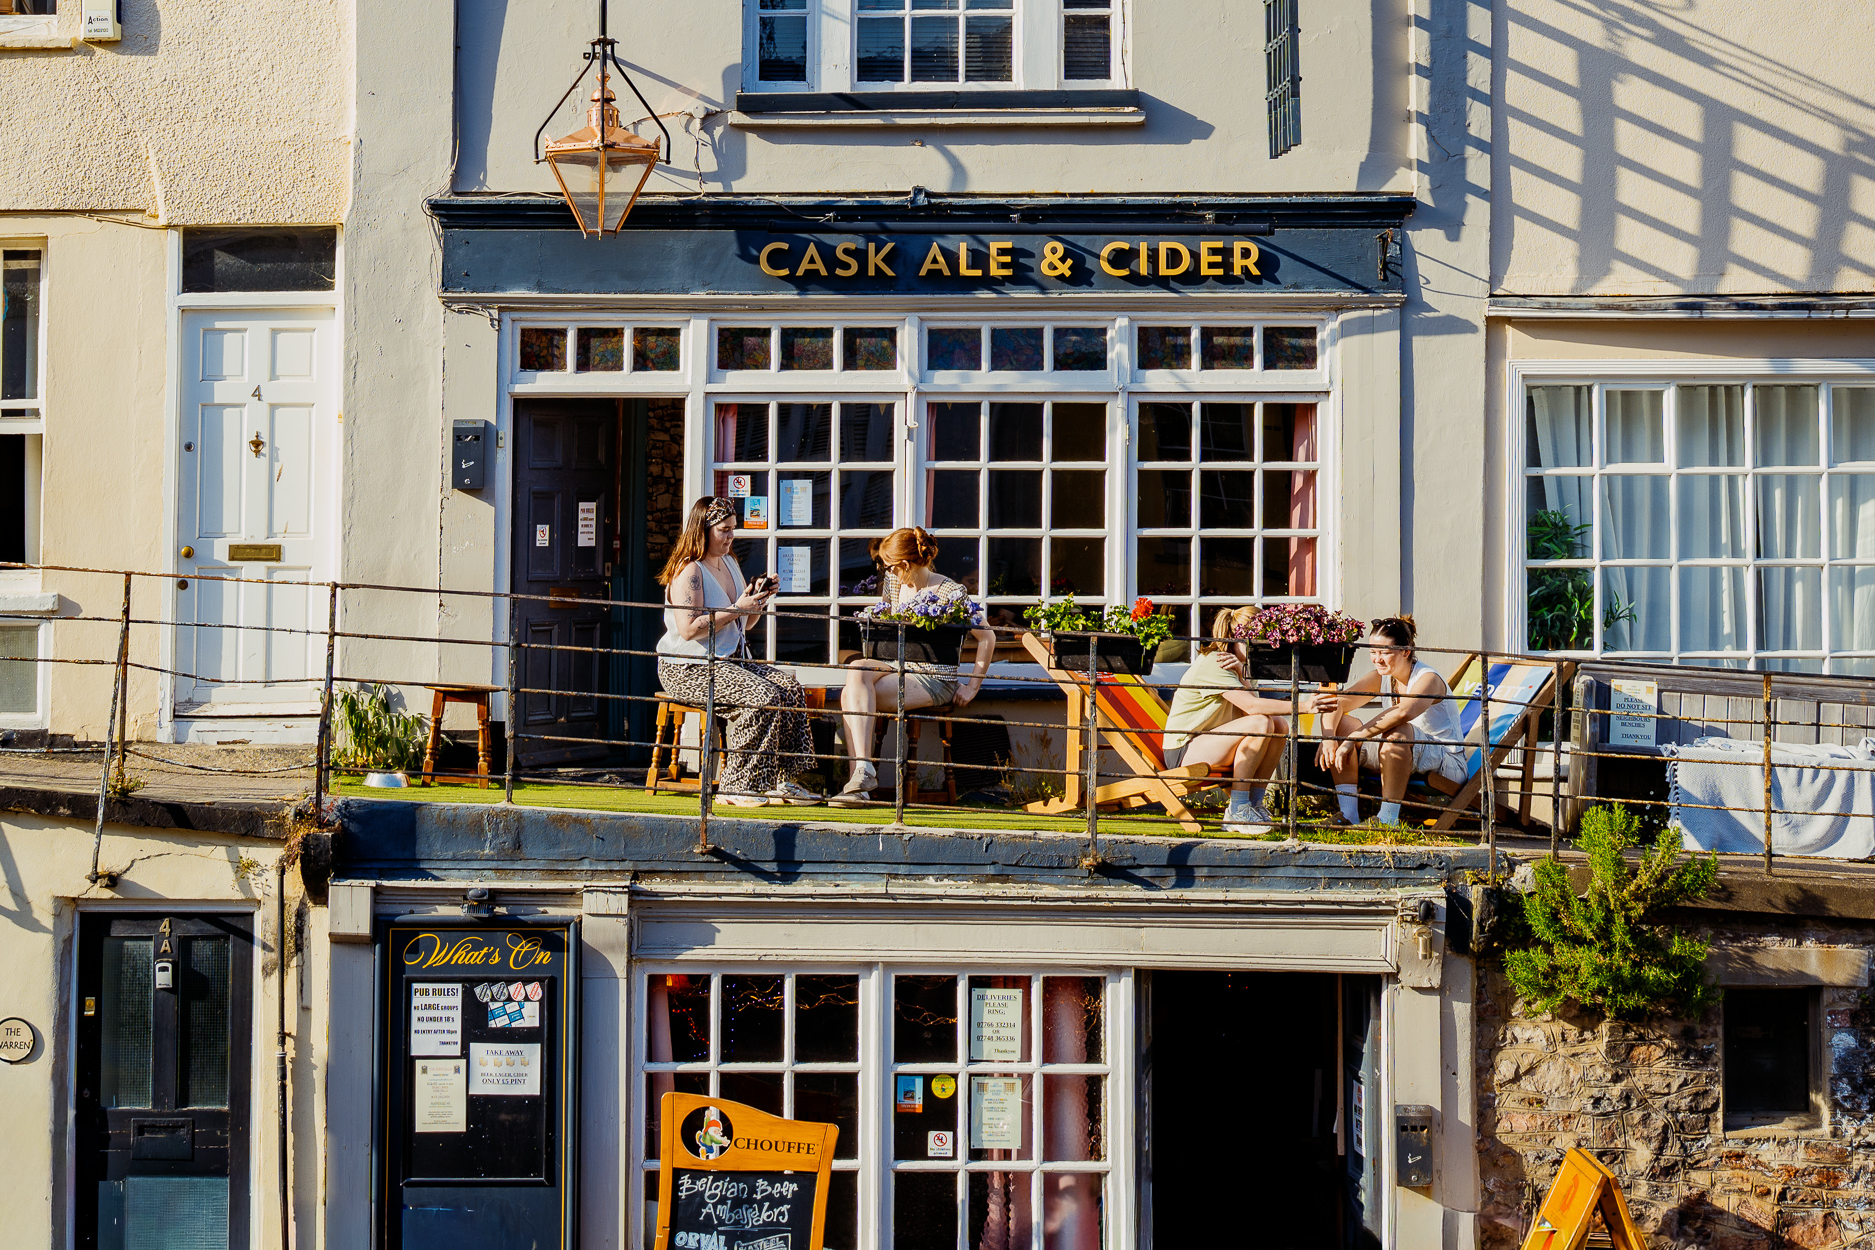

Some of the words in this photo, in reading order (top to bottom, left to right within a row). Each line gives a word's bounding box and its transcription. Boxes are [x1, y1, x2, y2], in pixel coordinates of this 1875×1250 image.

[88, 16, 108, 25] Action
[758, 241, 896, 277] CASK
[918, 241, 1014, 277] ALE
[1040, 241, 1073, 278] &
[1099, 241, 1261, 277] CIDER
[250, 384, 262, 402] 4
[158, 917, 171, 937] 4
[159, 939, 172, 953] A
[402, 933, 501, 969] What's
[506, 932, 552, 970] On
[413, 987, 430, 997] PUB
[431, 987, 459, 997] RULES!
[420, 1003, 440, 1011] LARGE
[5, 1027, 21, 1037] THE
[733, 1137, 816, 1155] CHOUFFE
[678, 1174, 748, 1203] Belgian
[753, 1178, 798, 1200] Beer
[674, 1230, 728, 1250] ORVAL
